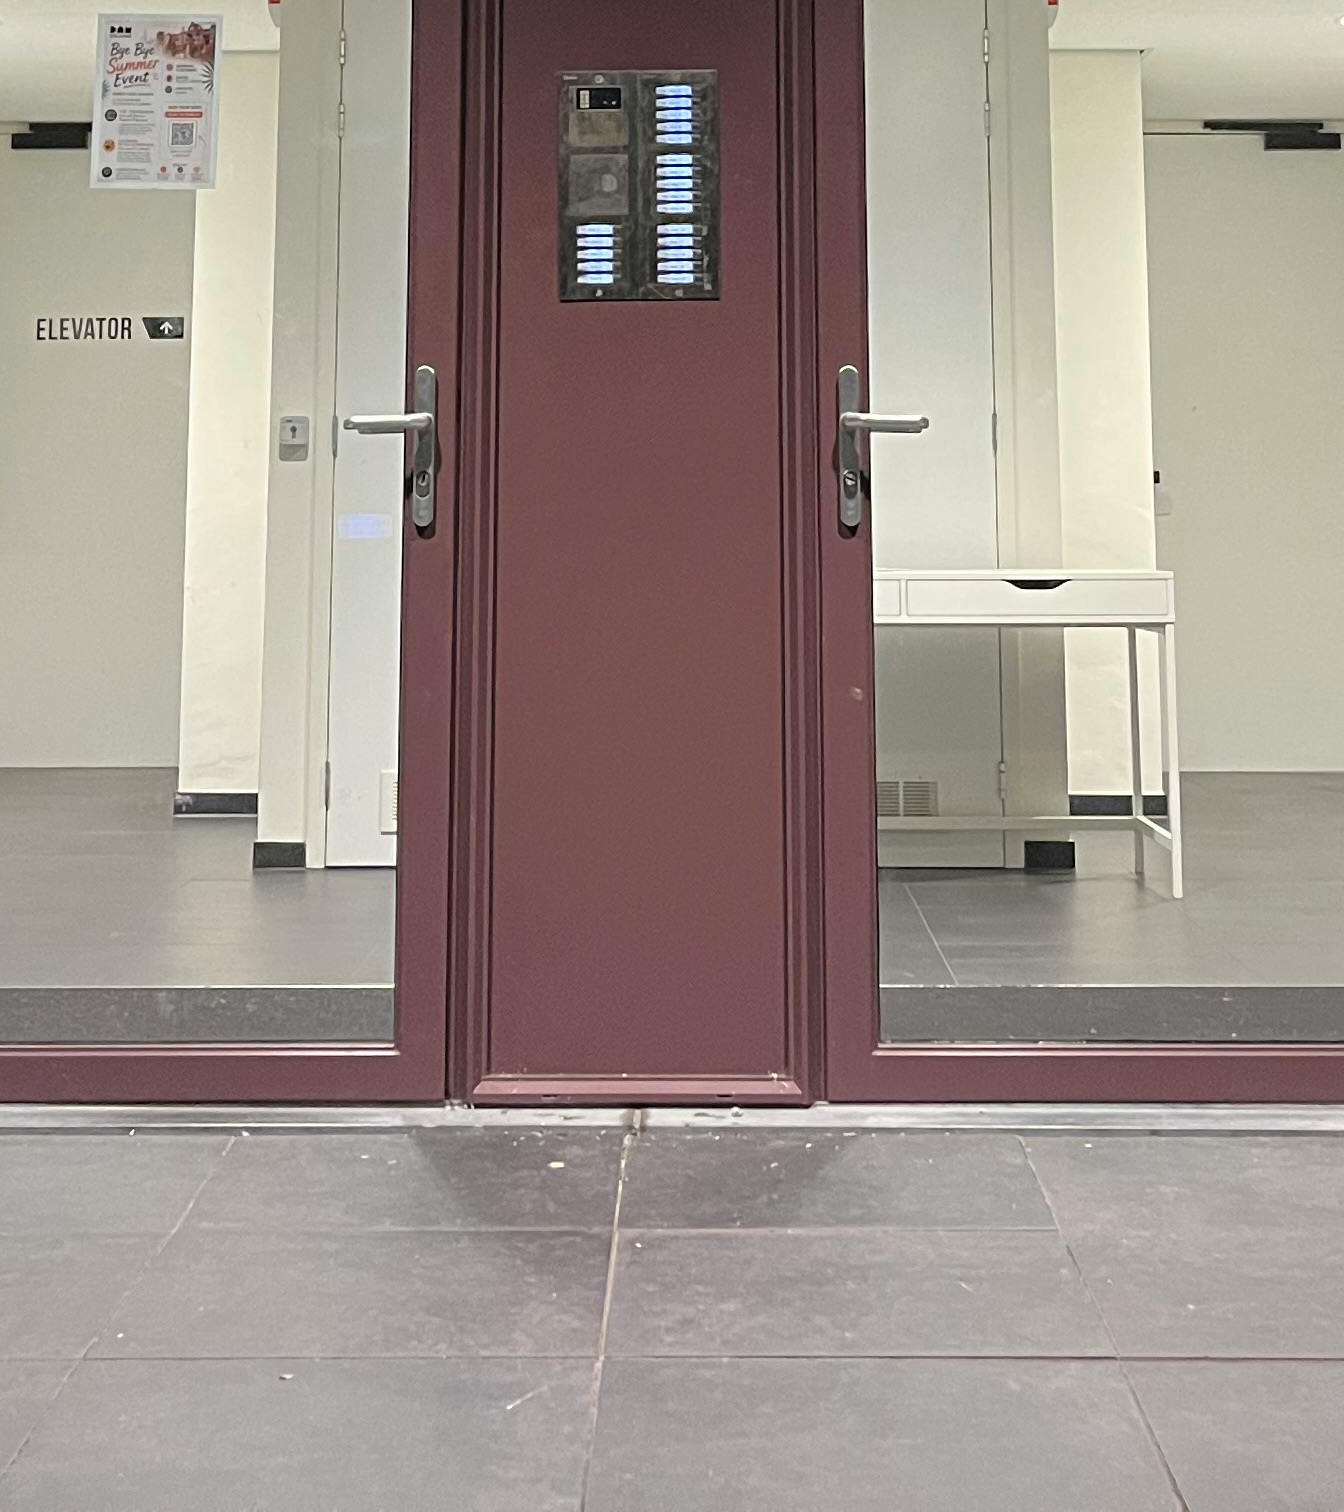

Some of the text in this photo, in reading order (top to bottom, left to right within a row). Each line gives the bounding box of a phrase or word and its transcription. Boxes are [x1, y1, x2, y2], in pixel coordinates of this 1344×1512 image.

[110, 42, 155, 58] Bye Bye
[107, 57, 159, 74] Summer
[113, 71, 149, 87] Event
[37, 317, 132, 340] ELEVATOR
